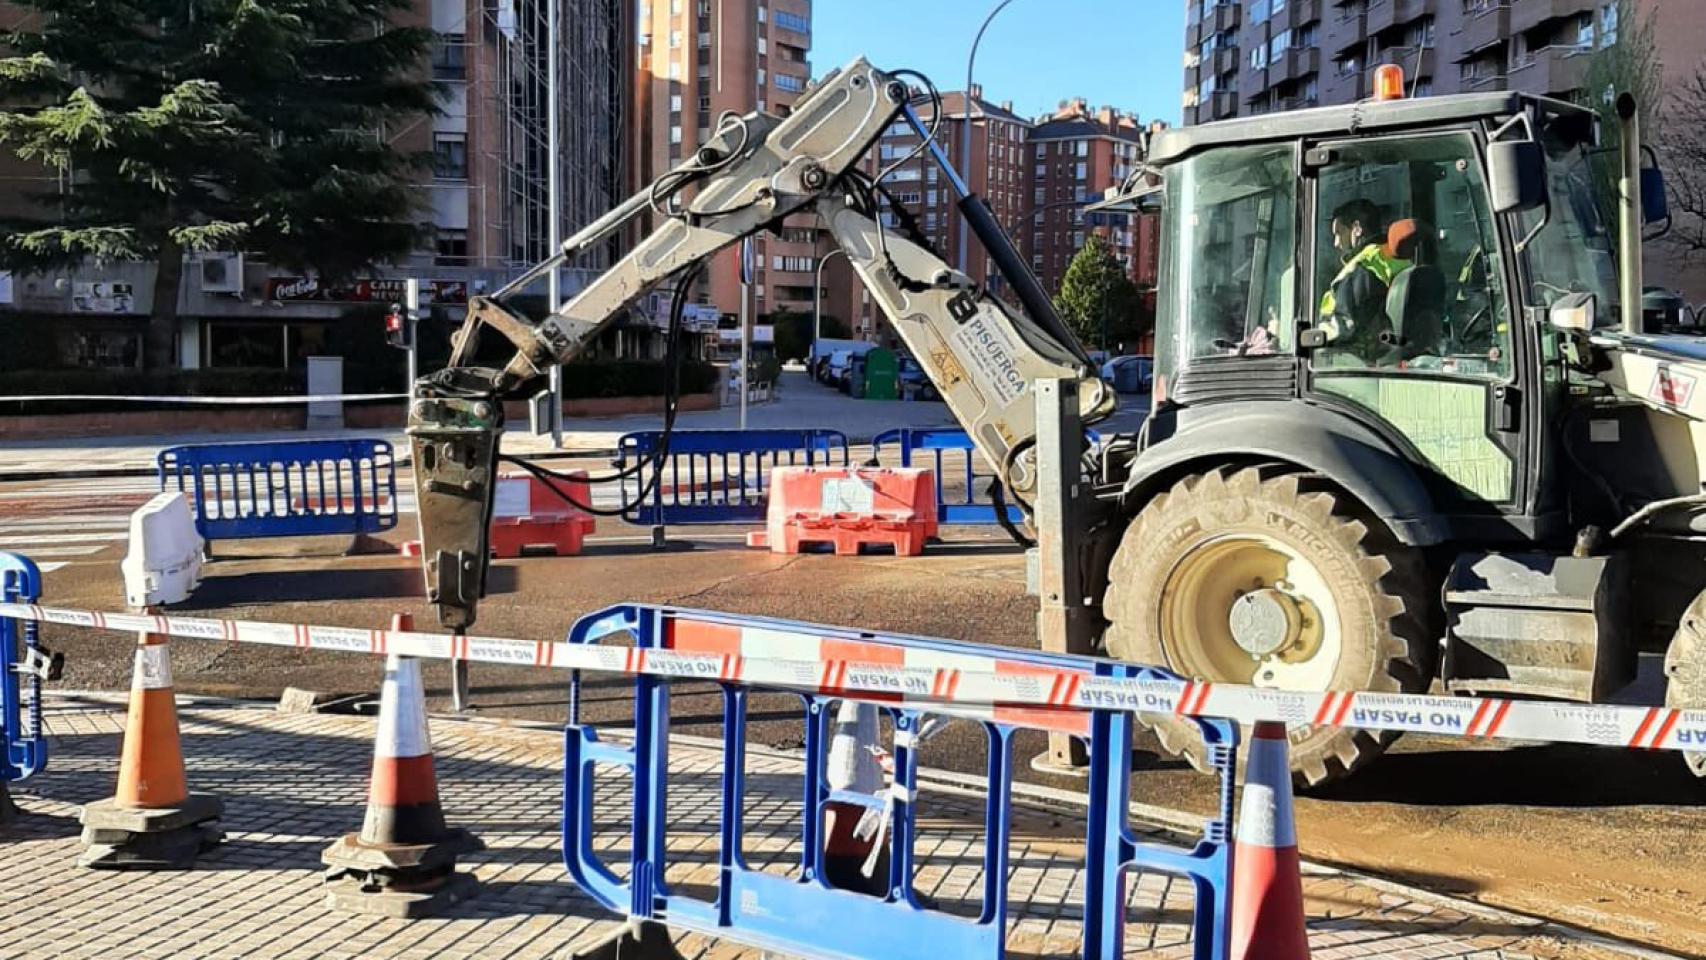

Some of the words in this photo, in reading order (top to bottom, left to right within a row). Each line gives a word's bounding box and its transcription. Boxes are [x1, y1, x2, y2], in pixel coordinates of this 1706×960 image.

[650, 658, 694, 673] PASAR
[696, 661, 718, 673] NO
[849, 672, 900, 687] PASAR
[905, 676, 928, 692] NO
[1080, 688, 1138, 706] PASAR
[1145, 693, 1172, 711] NO
[1353, 708, 1421, 725] PASAR
[1430, 713, 1461, 727] NO
